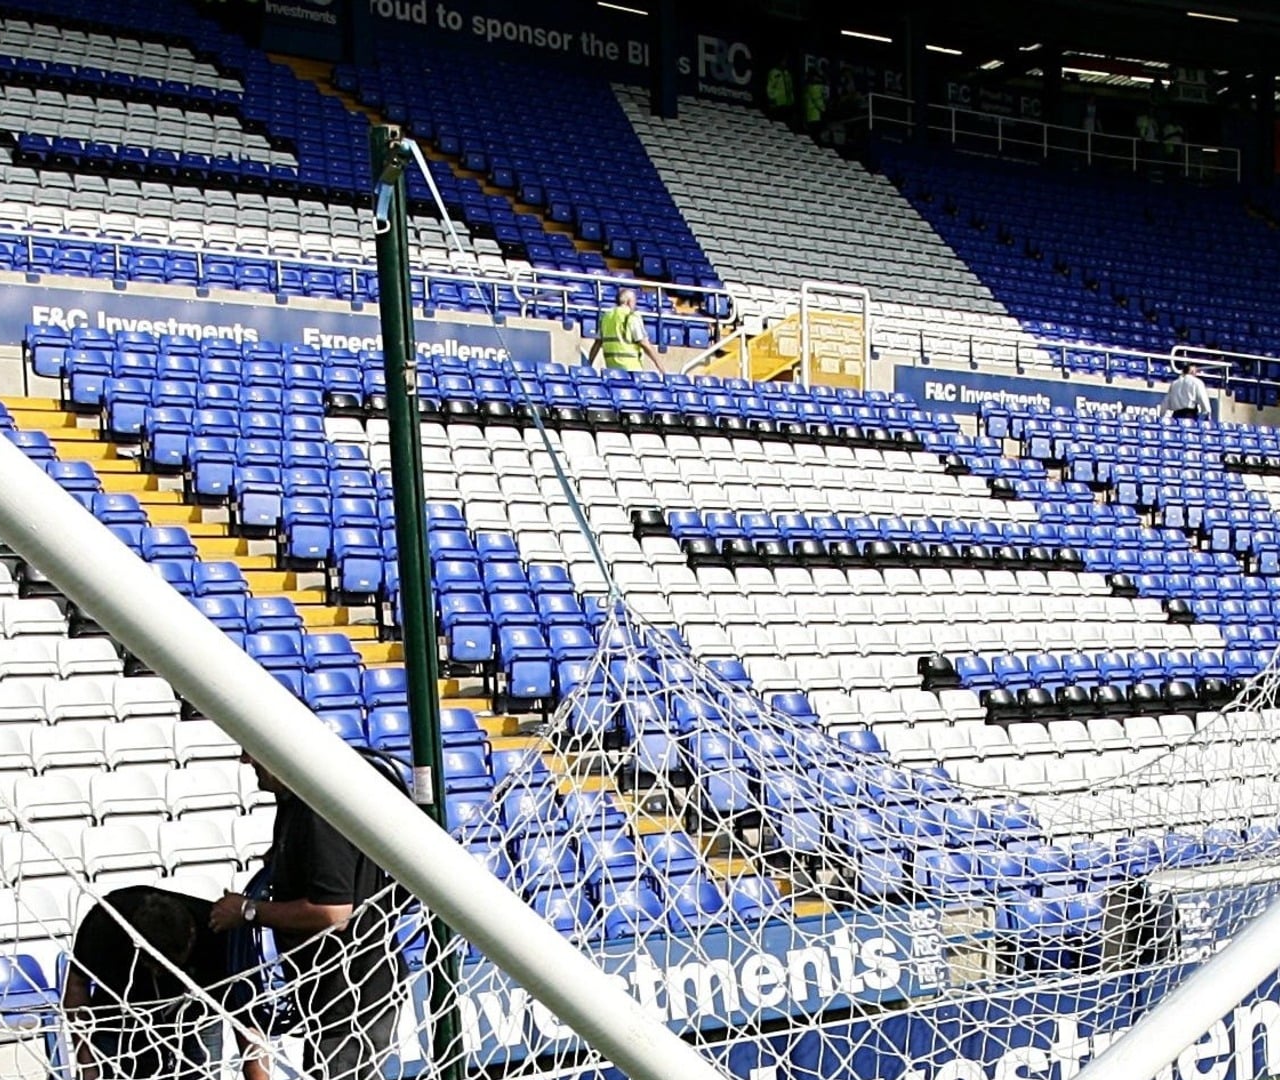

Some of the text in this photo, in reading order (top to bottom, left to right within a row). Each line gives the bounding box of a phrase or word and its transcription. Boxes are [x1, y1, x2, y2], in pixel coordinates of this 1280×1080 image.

[369, 0, 427, 25] roud
[435, 2, 463, 31] to
[472, 14, 571, 51] sponsor
[580, 31, 620, 61] the
[97, 310, 259, 344] Investments
[925, 381, 956, 402] F&C
